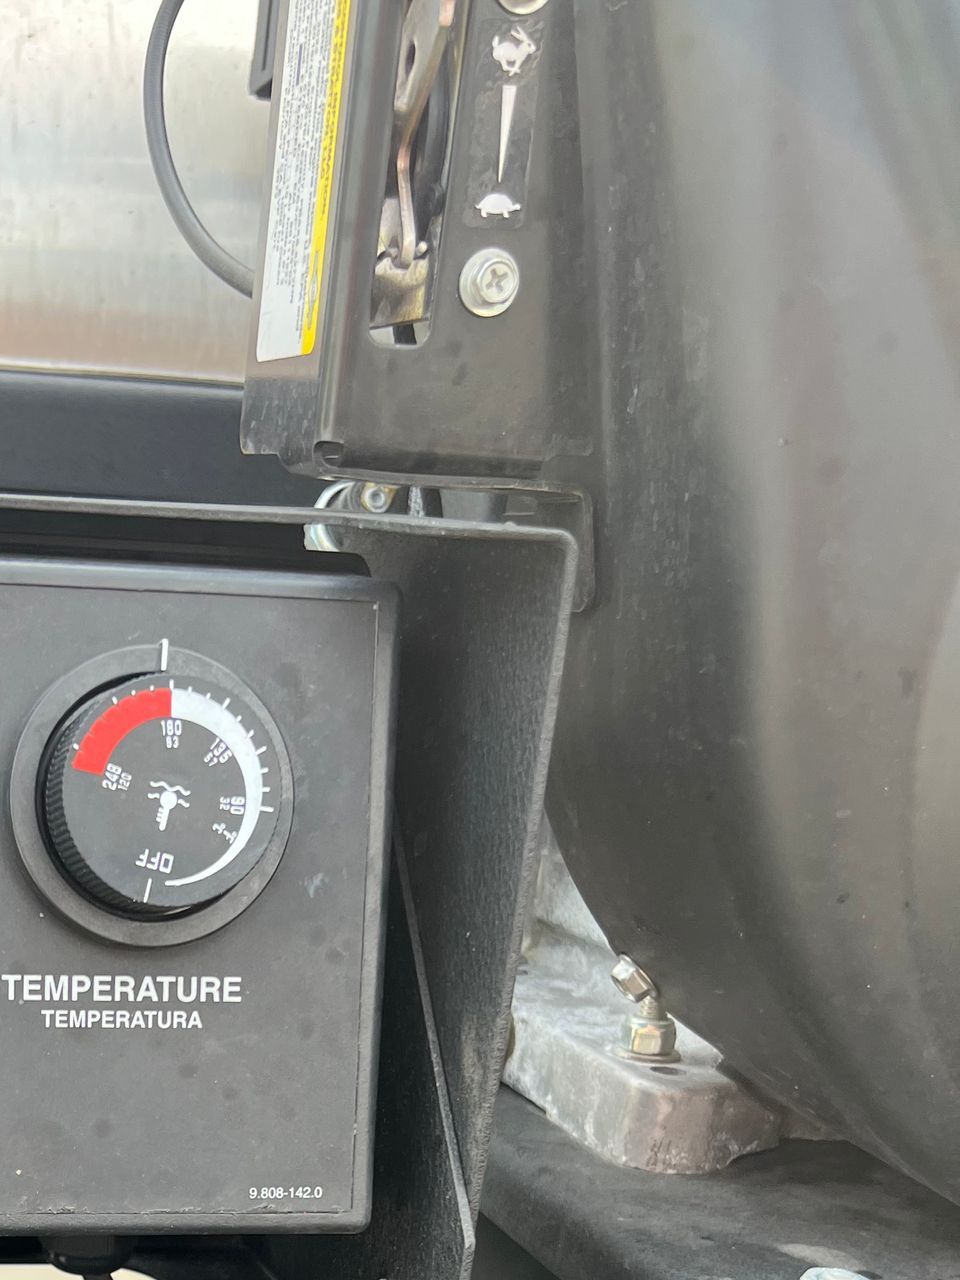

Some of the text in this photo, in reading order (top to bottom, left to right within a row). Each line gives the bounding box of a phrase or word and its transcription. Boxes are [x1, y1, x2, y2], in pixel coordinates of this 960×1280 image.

[160, 719, 182, 737] 180
[102, 763, 122, 791] 248
[117, 772, 132, 791] 120
[219, 796, 230, 811] 32
[230, 796, 246, 815] 90
[135, 849, 175, 874] OFF
[1, 974, 242, 1003] TEMPERATURE
[40, 1009, 203, 1029] TEMPERATURA
[249, 1186, 323, 1199] 9.808-142.0
